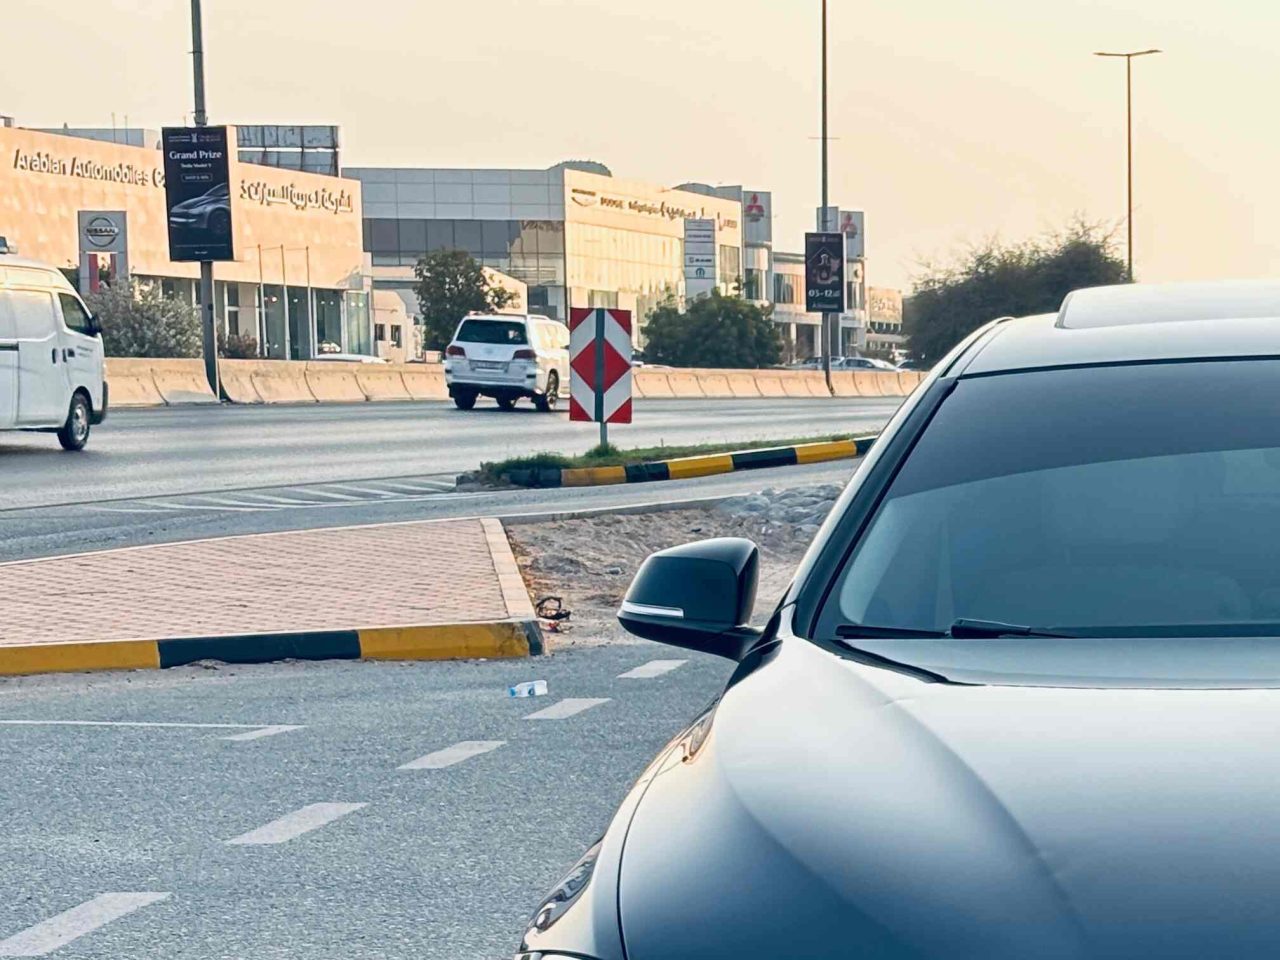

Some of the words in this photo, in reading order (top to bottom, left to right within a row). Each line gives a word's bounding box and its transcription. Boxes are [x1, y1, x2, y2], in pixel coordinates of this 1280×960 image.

[169, 151, 197, 159] Grand
[199, 150, 222, 159] Prize
[13, 149, 66, 175] Arabian
[70, 157, 149, 186] Automobiles
